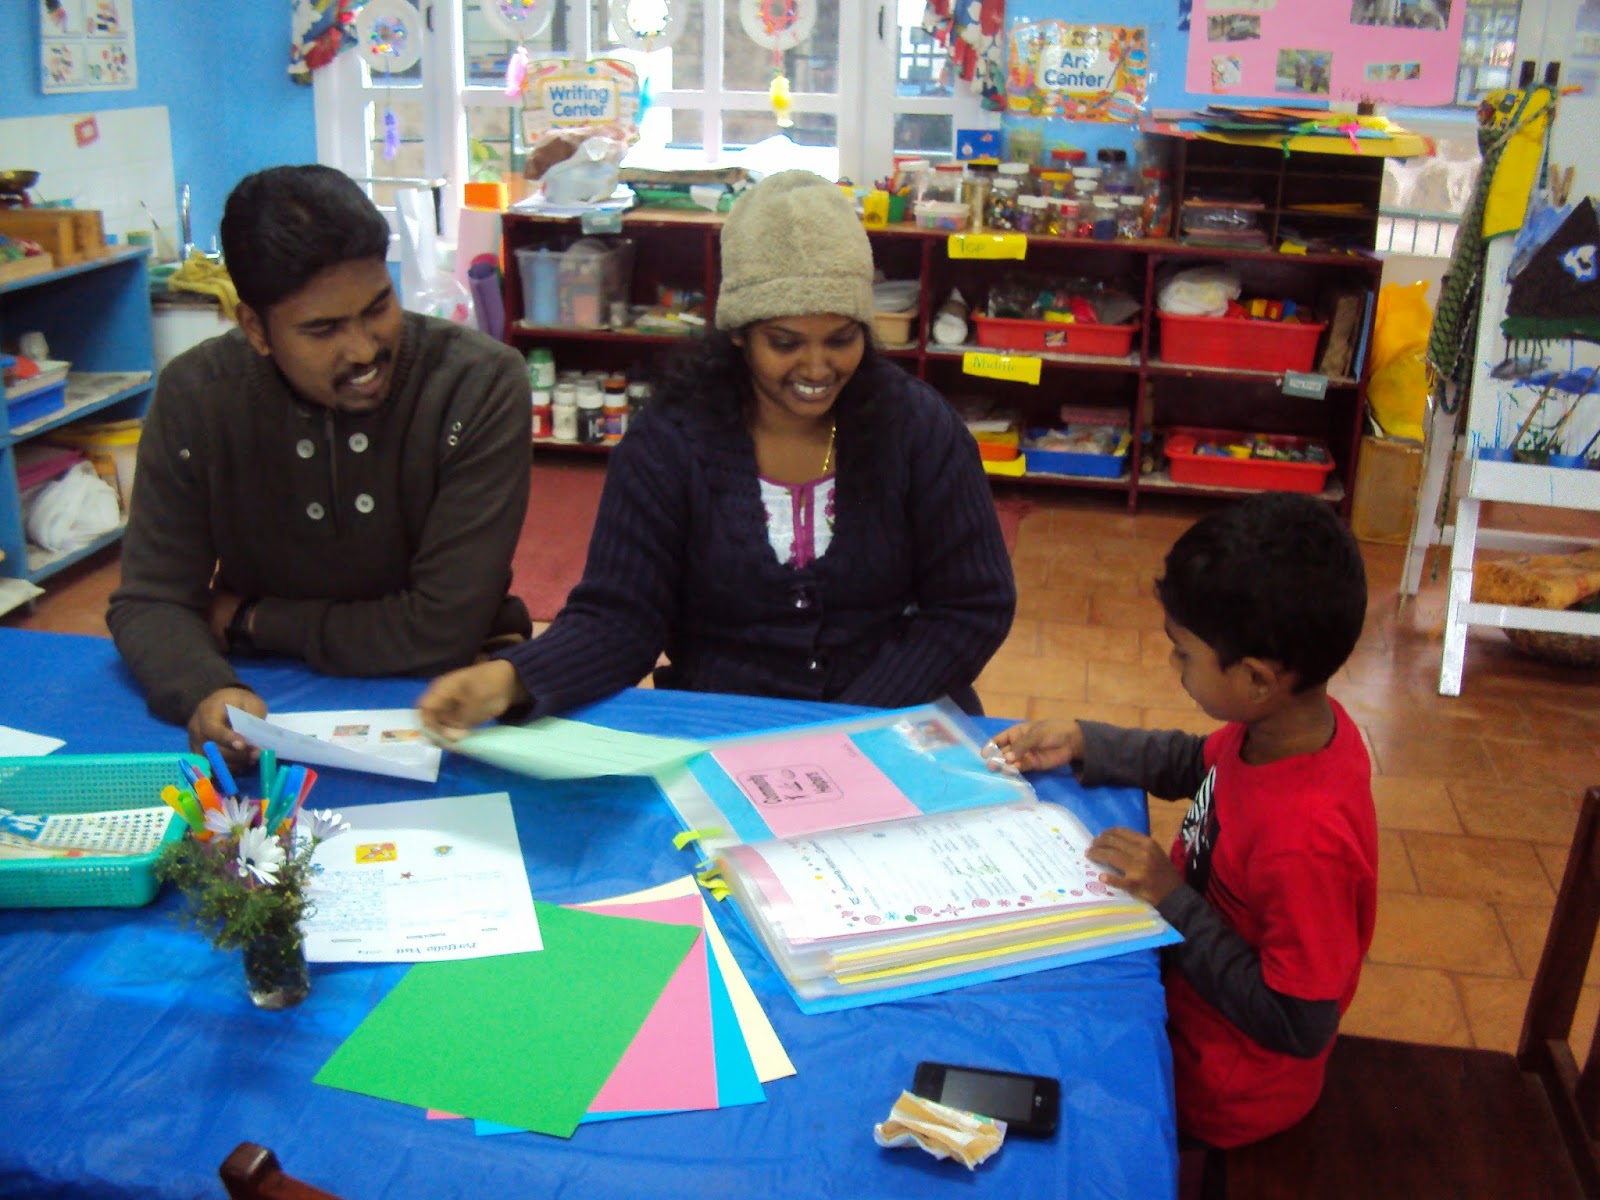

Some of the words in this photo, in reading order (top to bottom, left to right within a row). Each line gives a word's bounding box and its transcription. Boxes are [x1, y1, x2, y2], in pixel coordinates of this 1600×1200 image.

[1044, 68, 1104, 87] Center
[549, 86, 608, 104] Writing
[552, 102, 606, 117] Center
